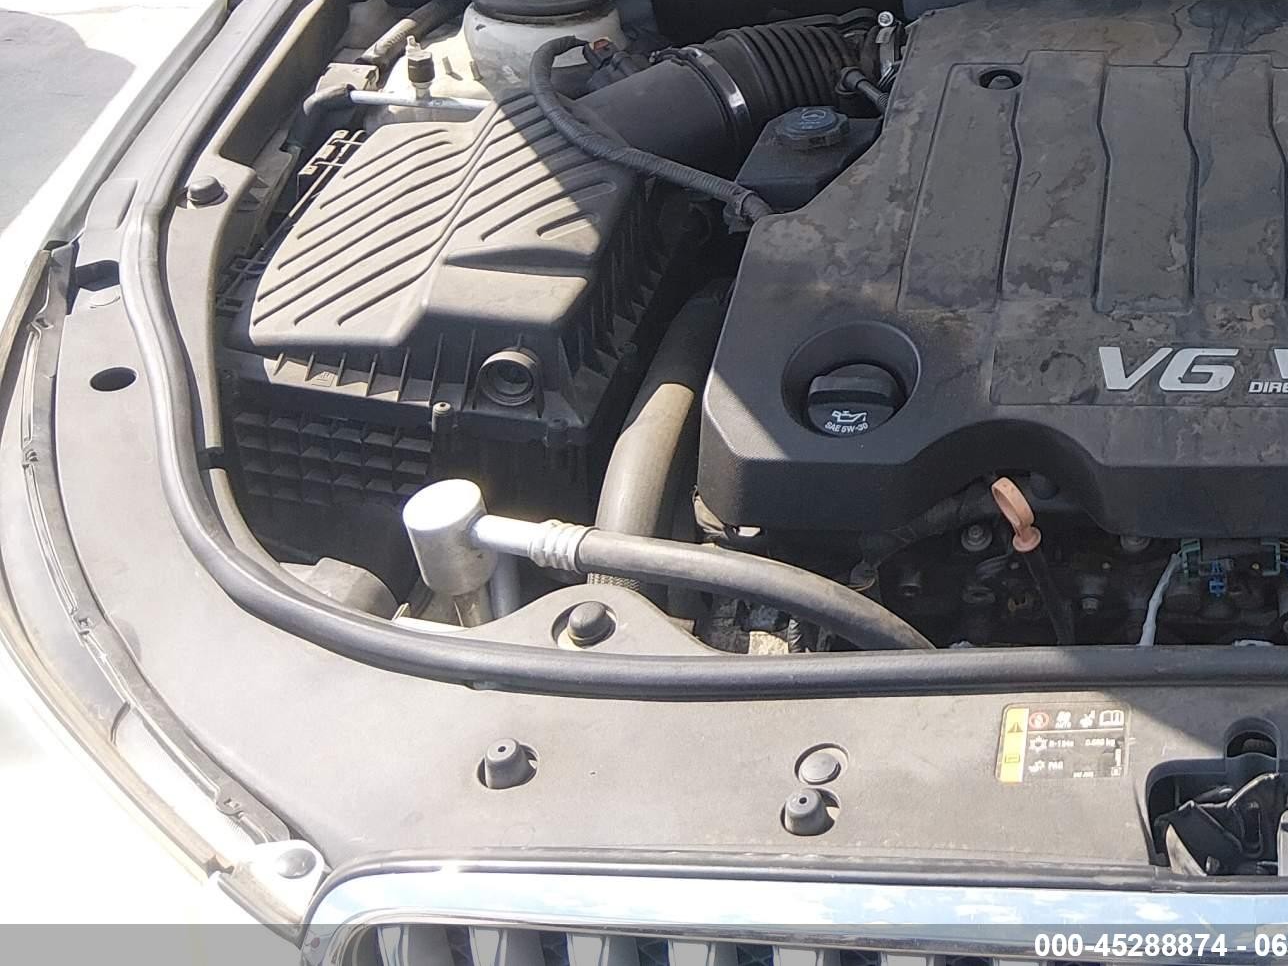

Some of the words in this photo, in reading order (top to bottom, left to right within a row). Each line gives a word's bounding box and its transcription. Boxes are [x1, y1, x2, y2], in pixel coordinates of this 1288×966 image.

[1098, 346, 1240, 392] V6
[824, 421, 840, 432] SAE
[841, 422, 869, 433] 5W-30
